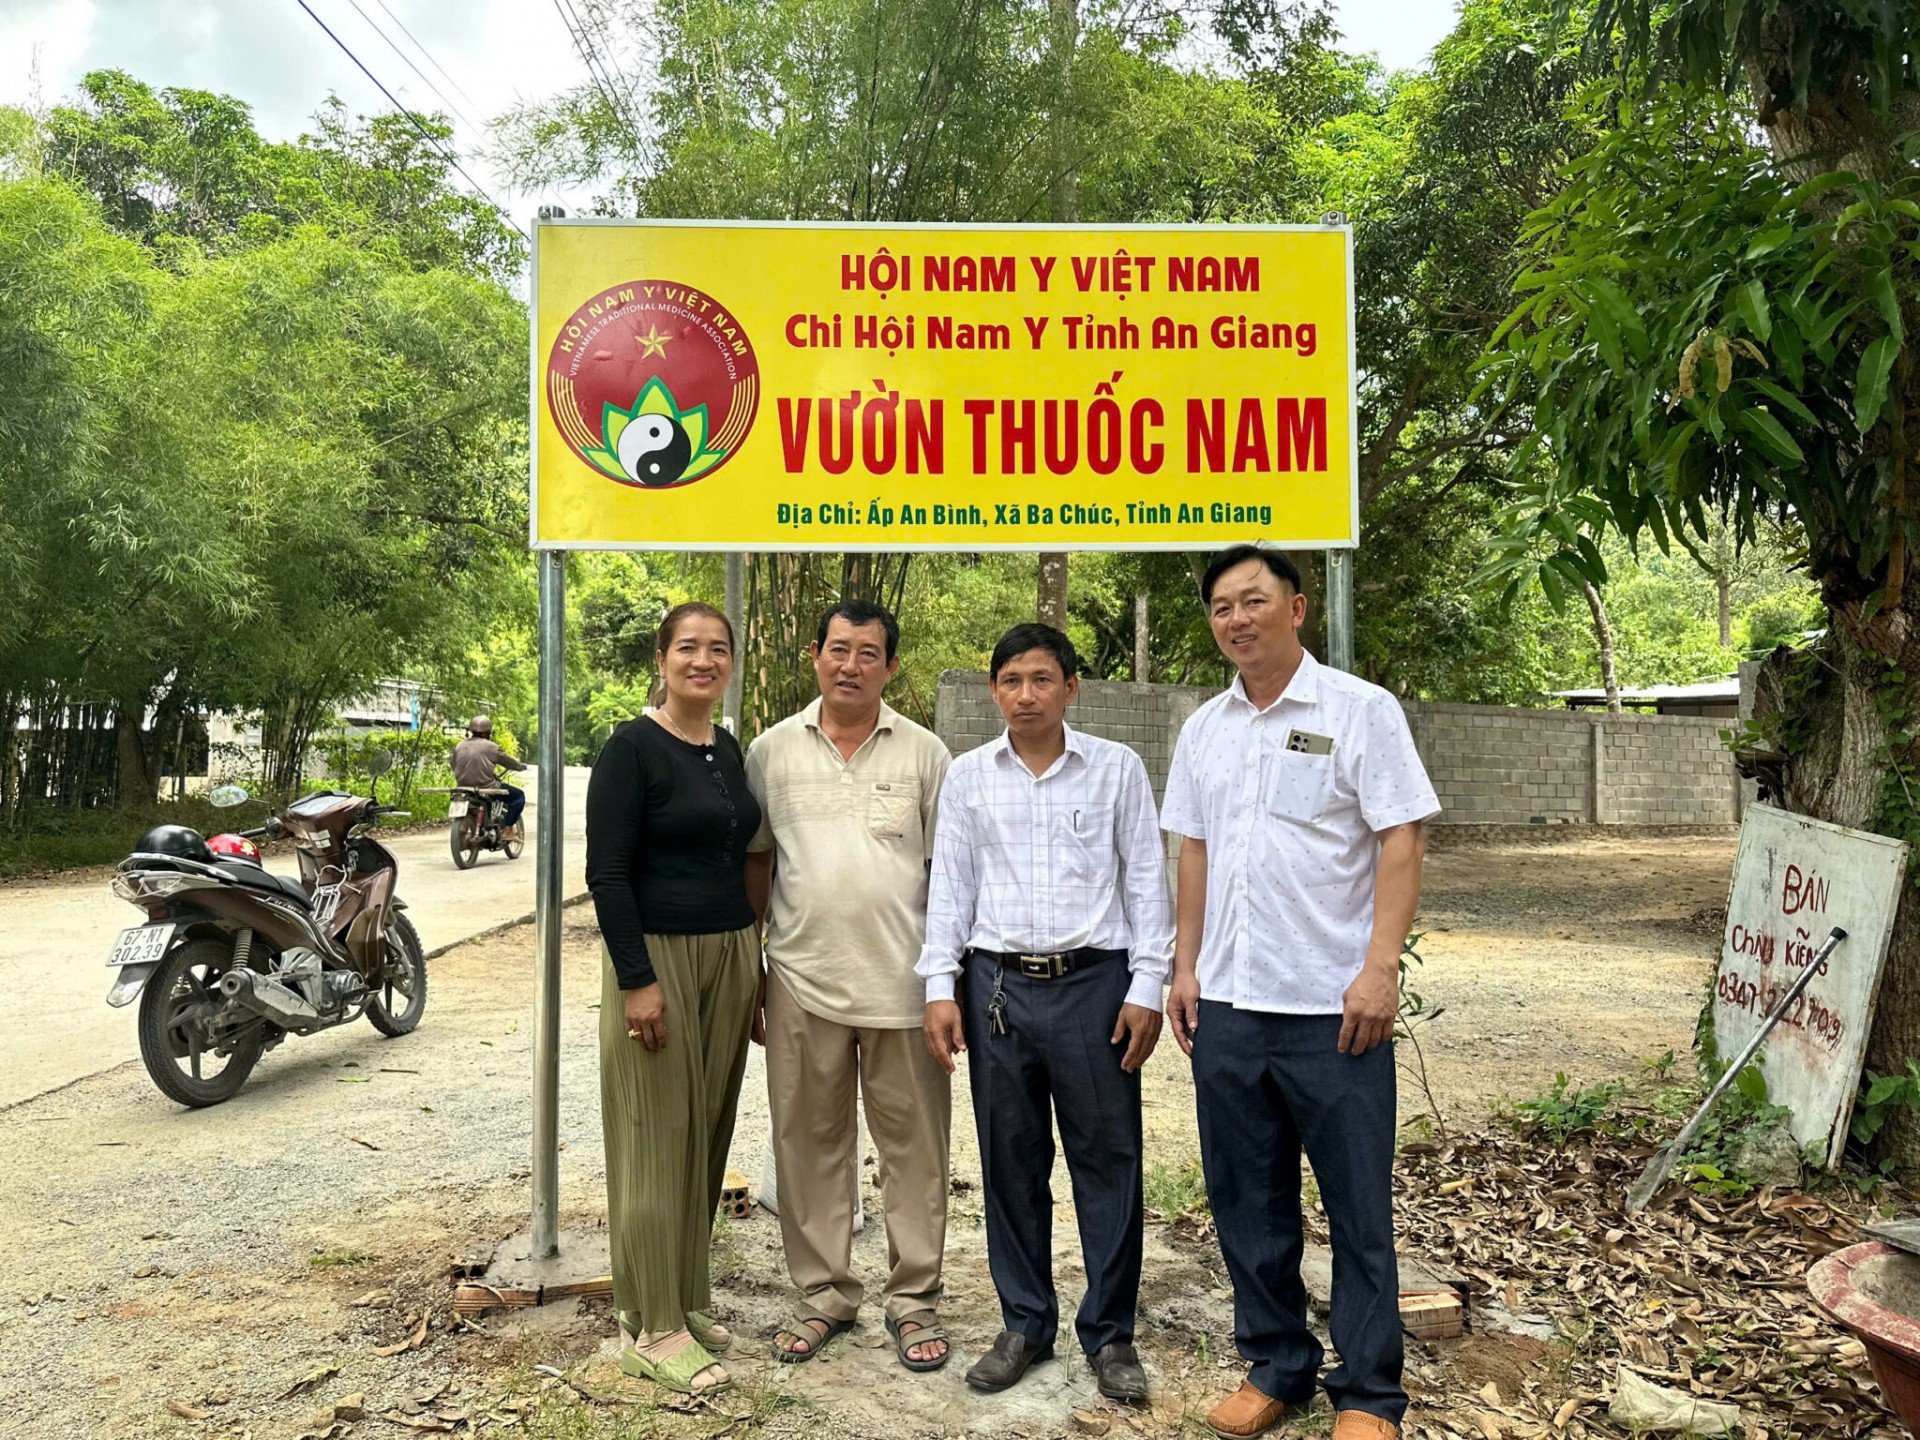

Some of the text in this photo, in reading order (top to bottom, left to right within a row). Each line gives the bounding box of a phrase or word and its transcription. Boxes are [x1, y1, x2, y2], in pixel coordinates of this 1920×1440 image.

[842, 247, 1260, 300] HỘI NAM Y VIỆT NAM
[560, 285, 748, 358] HỘI NAM Y VIỆT NAM
[569, 303, 738, 381] VIETNAMESE TRADITIONAL MEDICINE ASSOCIATION
[786, 313, 1317, 357] Chi Hội Nam Y Tỉnh An Giang
[777, 371, 1328, 476] VƯỜN THUỐC NAM
[777, 497, 1272, 529] Địa Chỉ: Ấp An Bình, Xã Ba Chúc, Tỉnh An Giang
[1781, 864, 1830, 915] BÁN
[110, 943, 163, 963] 302.39
[123, 927, 165, 946] 67-N1
